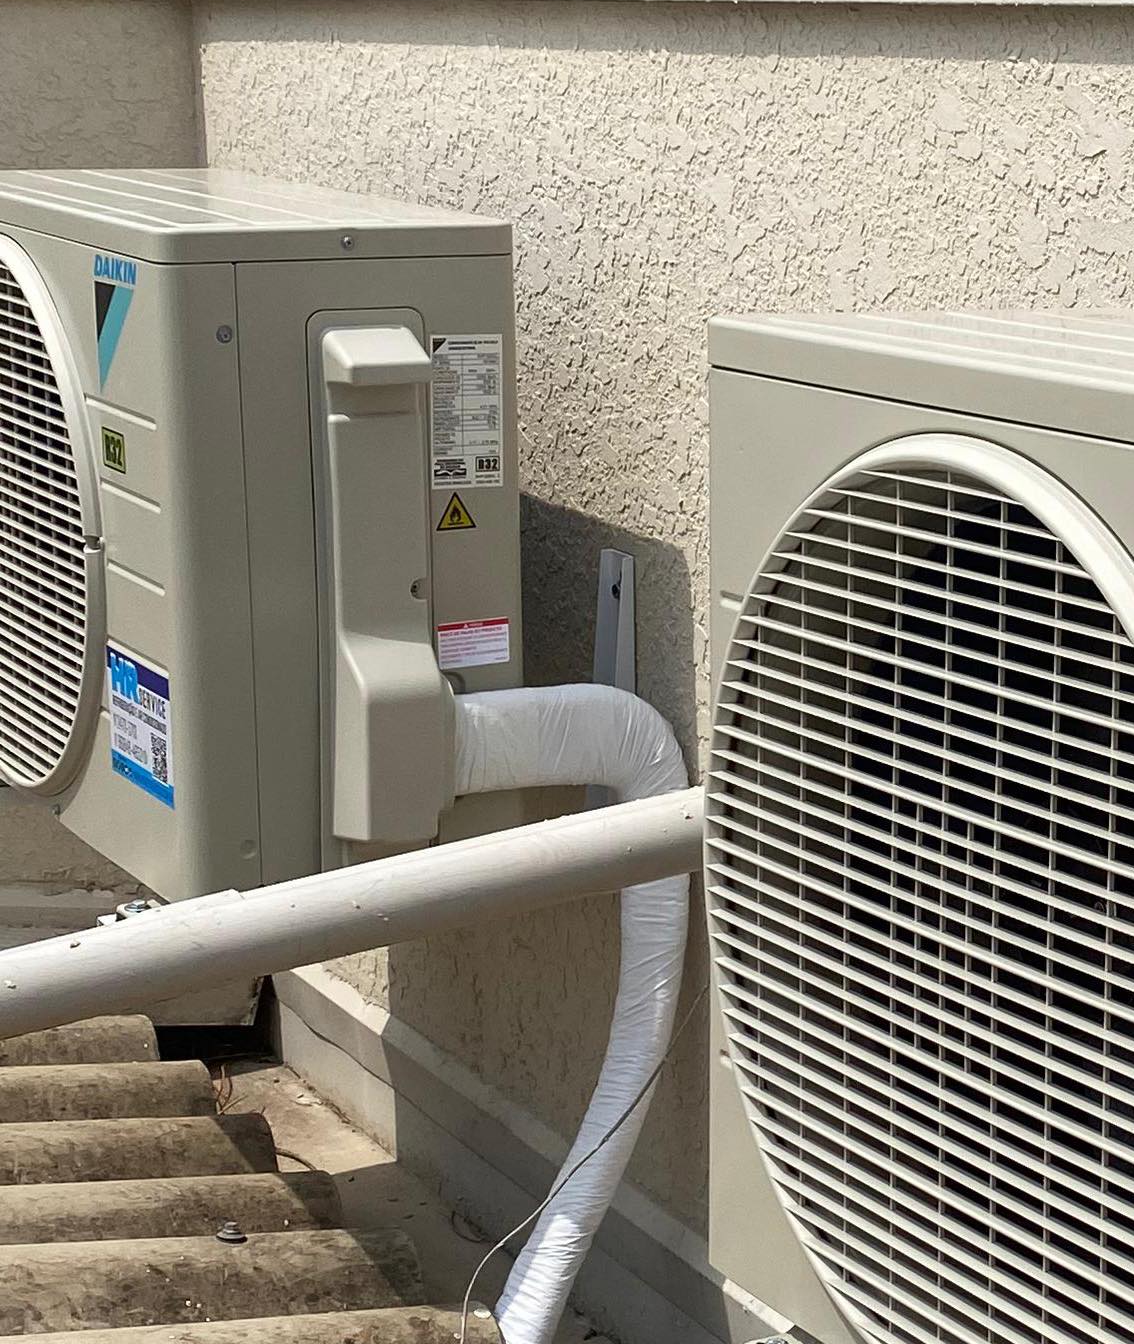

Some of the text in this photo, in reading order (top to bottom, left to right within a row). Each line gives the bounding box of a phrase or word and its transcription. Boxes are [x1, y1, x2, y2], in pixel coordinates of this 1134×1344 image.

[94, 253, 136, 285] DAIKIN
[105, 434, 123, 466] R32
[110, 652, 140, 704] HR
[139, 687, 167, 720] SERVICE
